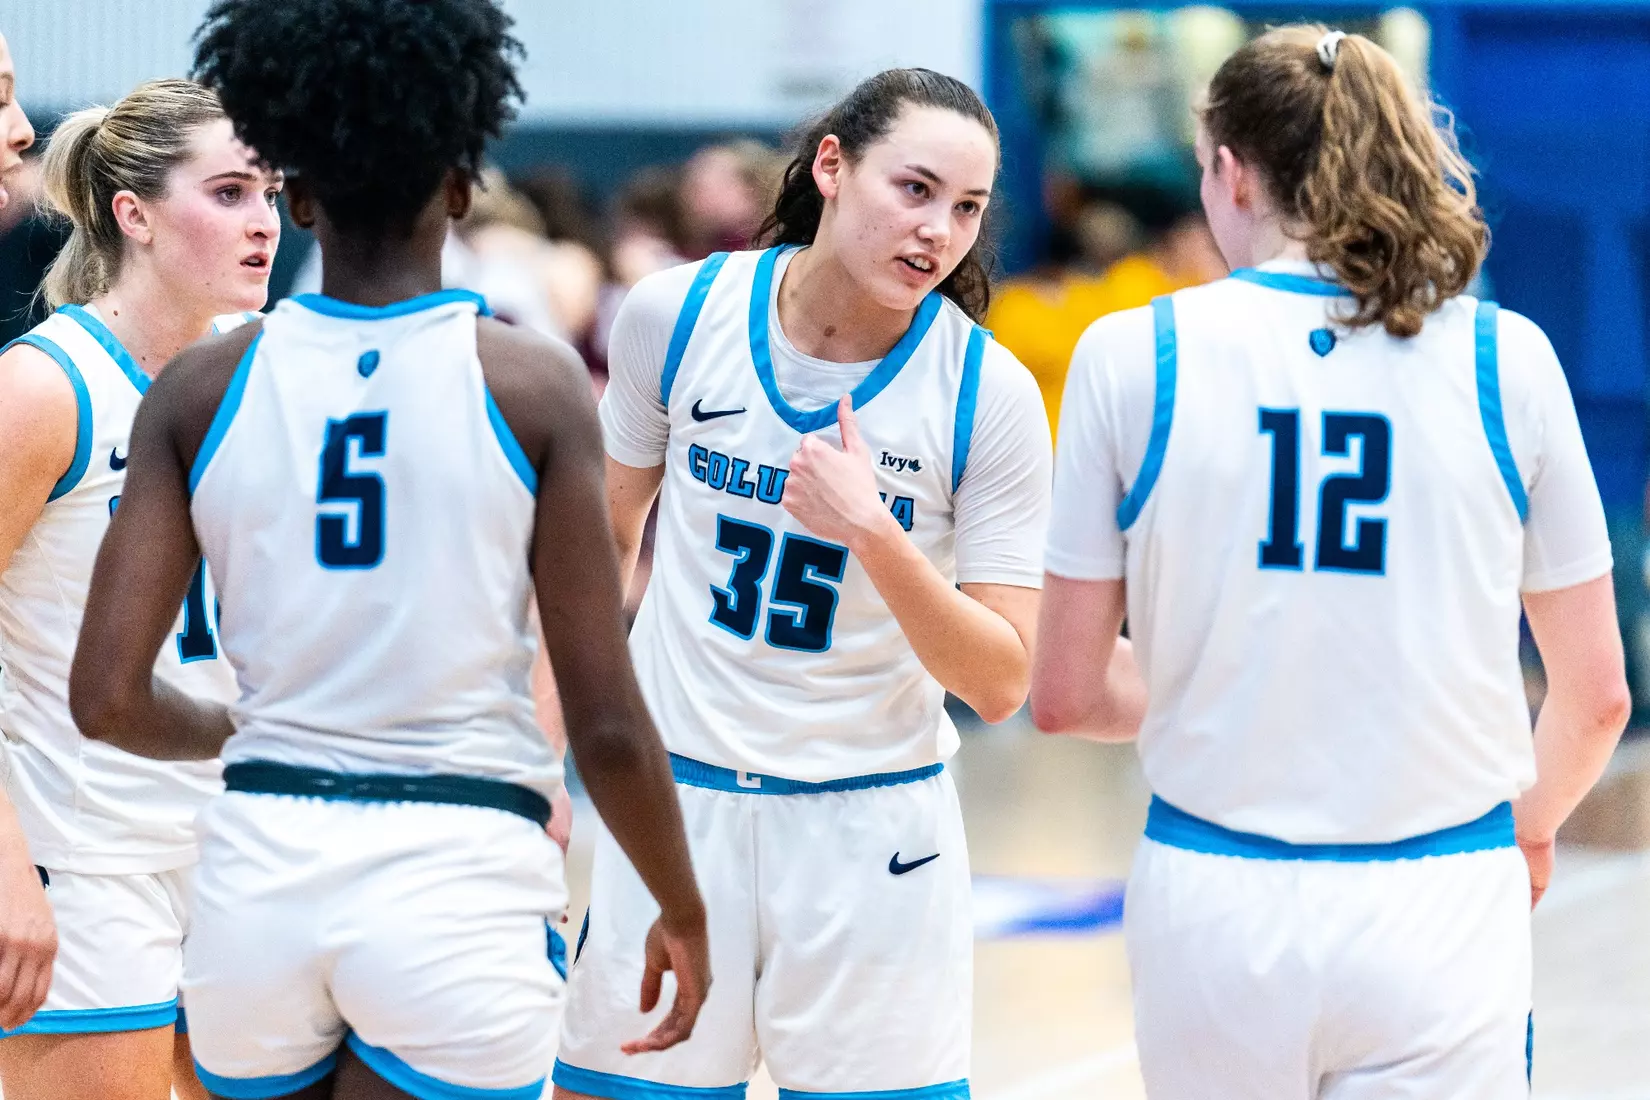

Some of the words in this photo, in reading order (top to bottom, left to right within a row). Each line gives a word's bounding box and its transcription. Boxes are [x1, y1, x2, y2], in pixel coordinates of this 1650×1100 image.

[315, 409, 388, 570] 5
[689, 442, 915, 532] COLUA
[880, 451, 908, 472] Ivy
[1257, 406, 1393, 577] 12
[176, 553, 222, 664] 1
[708, 513, 850, 653] 35
